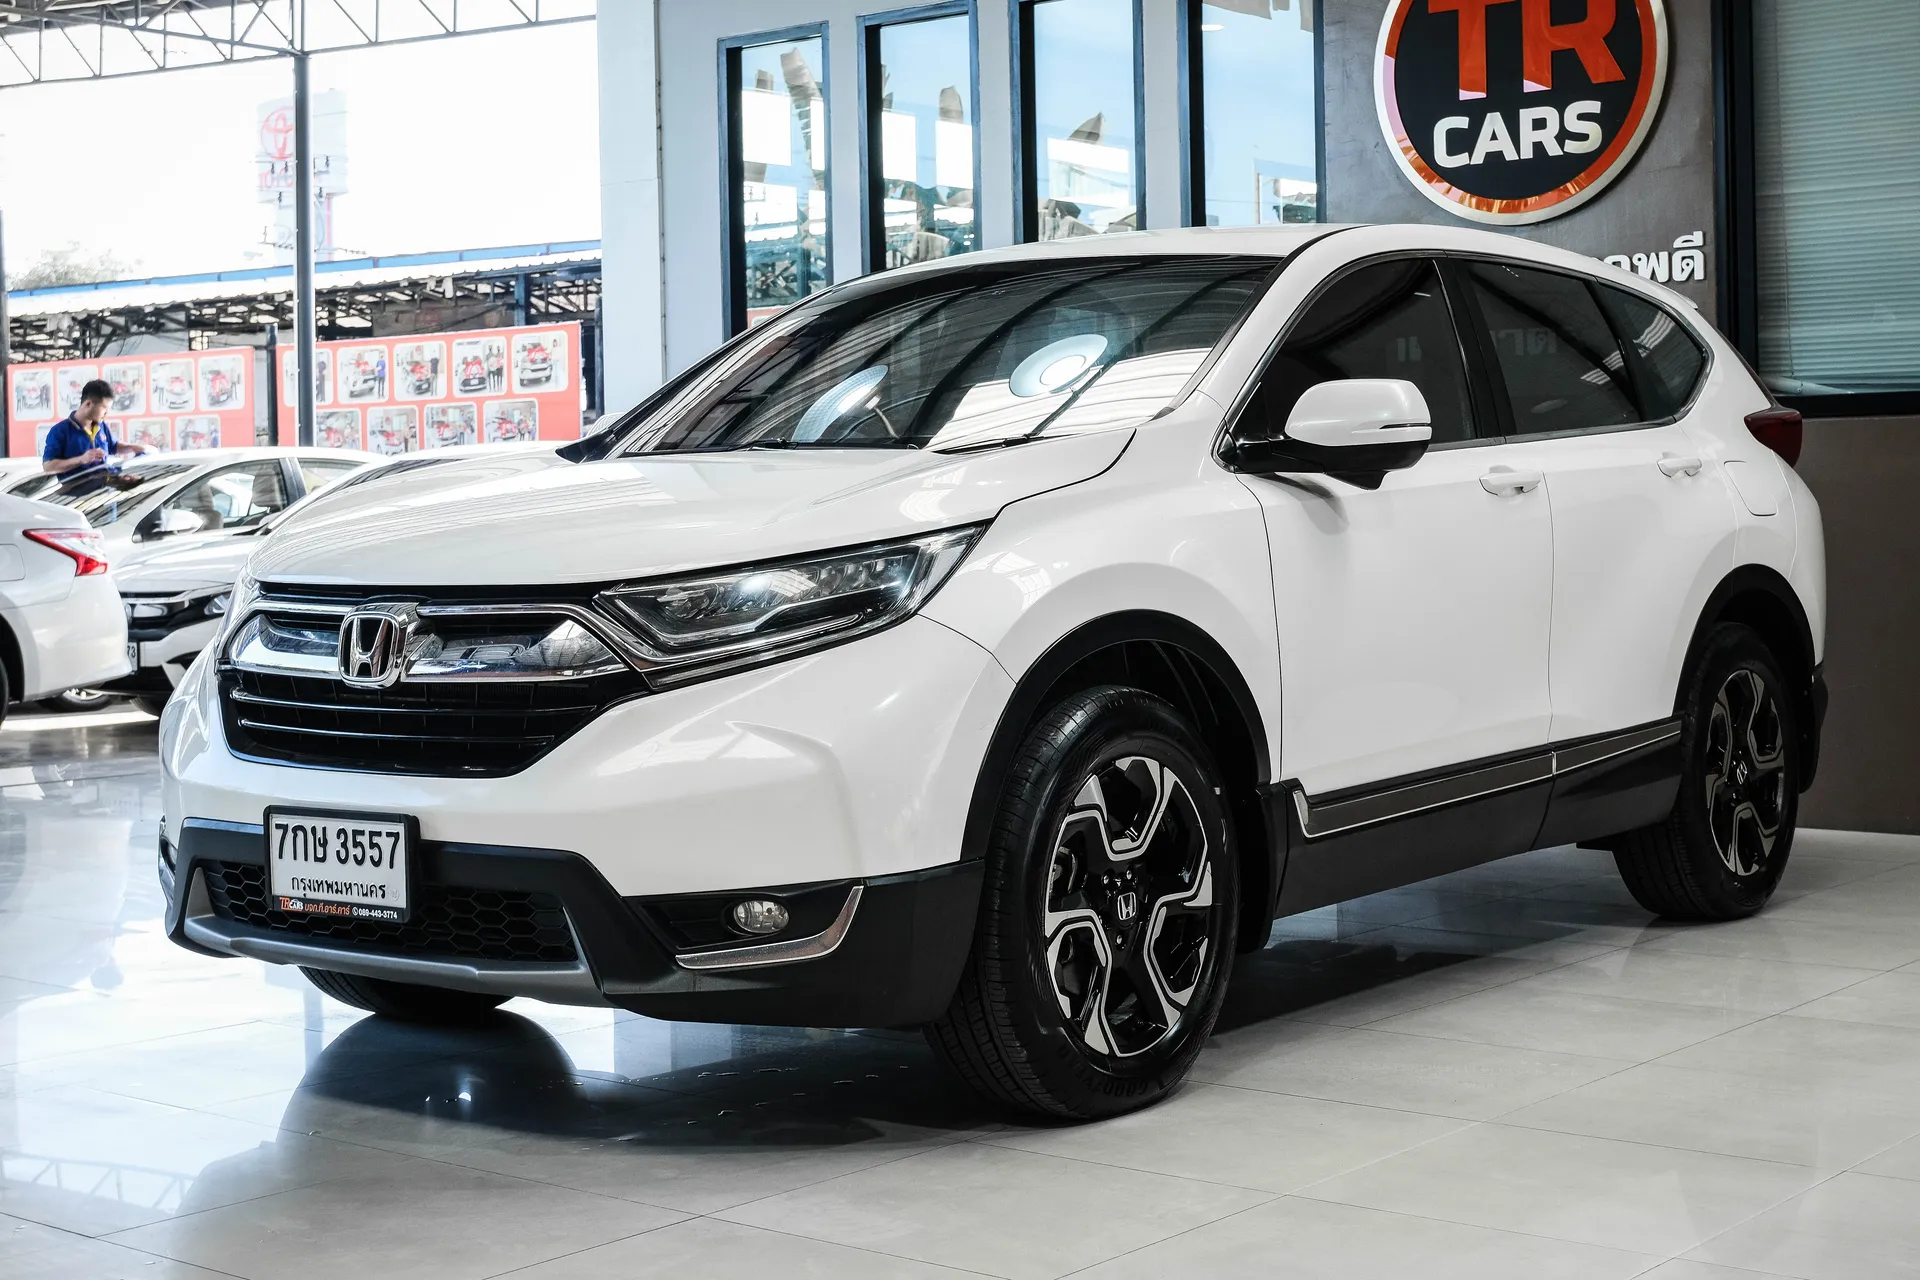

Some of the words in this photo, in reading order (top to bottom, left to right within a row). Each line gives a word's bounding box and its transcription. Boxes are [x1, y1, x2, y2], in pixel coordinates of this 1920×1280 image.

[1427, 0, 1627, 101] TR
[1433, 100, 1602, 169] CARS
[275, 823, 329, 863] 7กษ
[335, 827, 400, 869] 3557
[291, 876, 386, 899] กรุงเทพมหานคร
